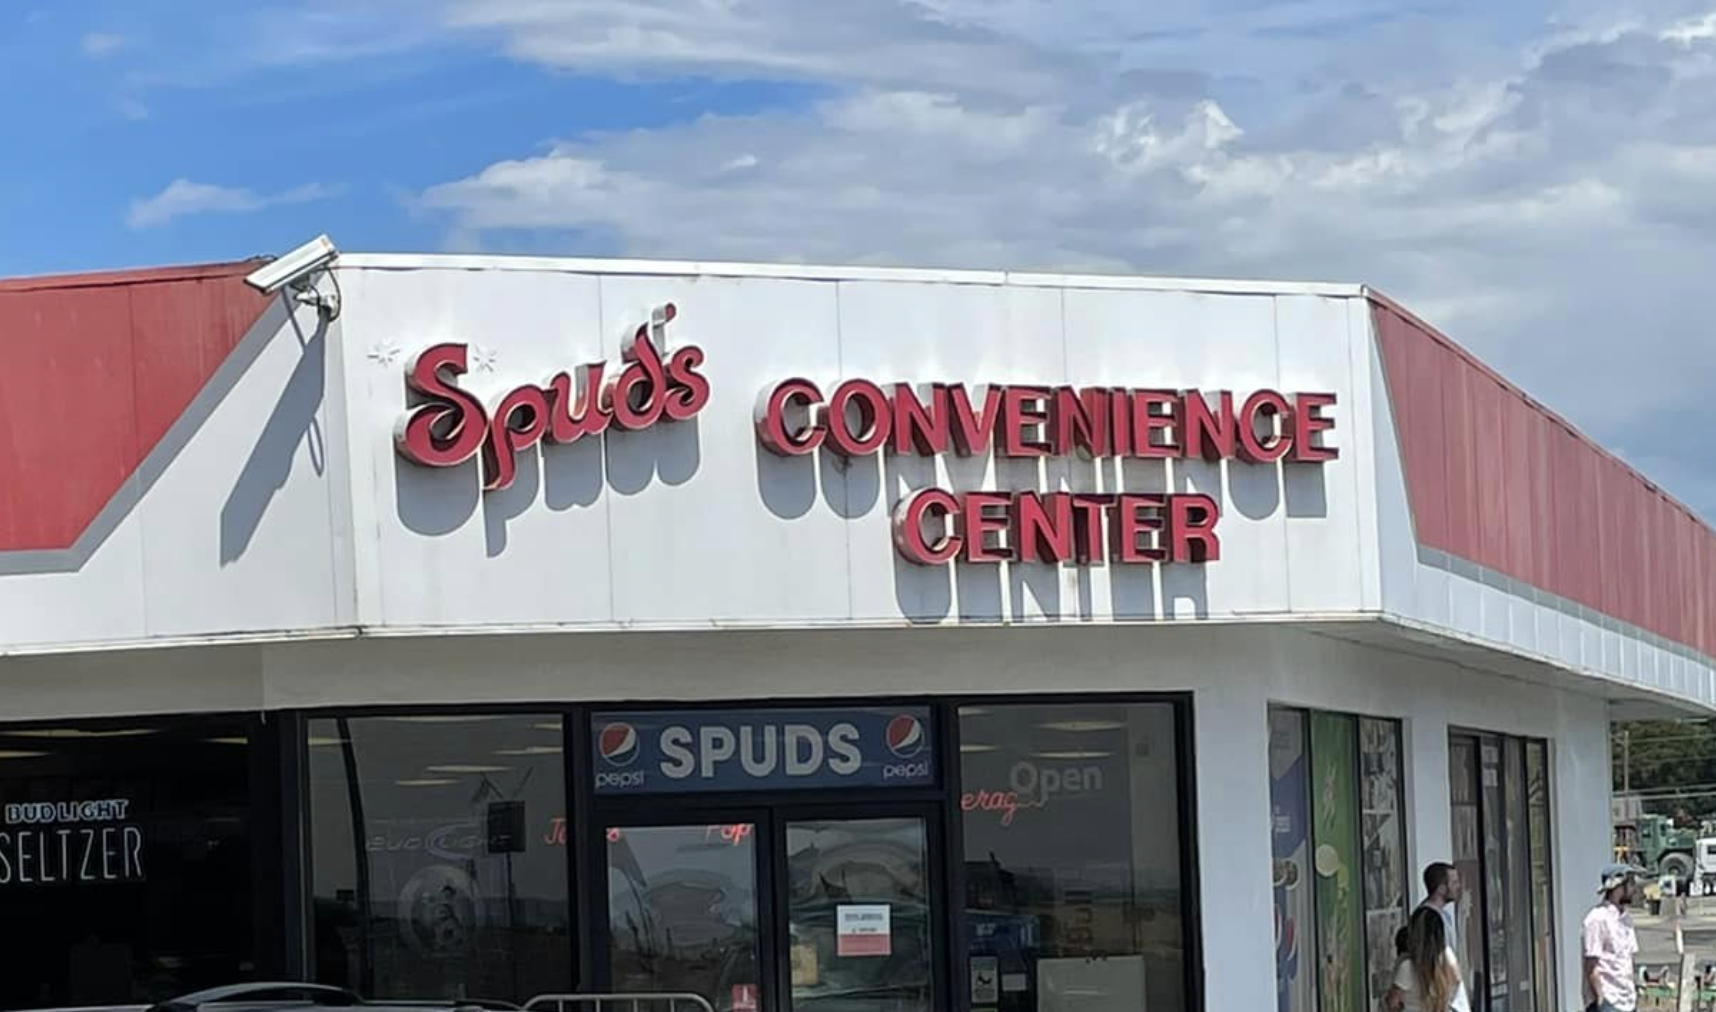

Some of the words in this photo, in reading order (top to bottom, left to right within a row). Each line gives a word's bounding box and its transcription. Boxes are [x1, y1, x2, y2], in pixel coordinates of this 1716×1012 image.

[395, 302, 710, 491] Spud's
[755, 377, 1340, 463] CONVENIENCE
[894, 487, 1220, 565] CENTER
[659, 723, 863, 779] SPUDS
[883, 761, 930, 780] pepsi
[595, 770, 645, 789] pepsi
[1010, 761, 1103, 807] Open
[5, 802, 56, 824] BUD
[57, 799, 129, 822] LIGHT
[0, 826, 144, 884] SELTZER
